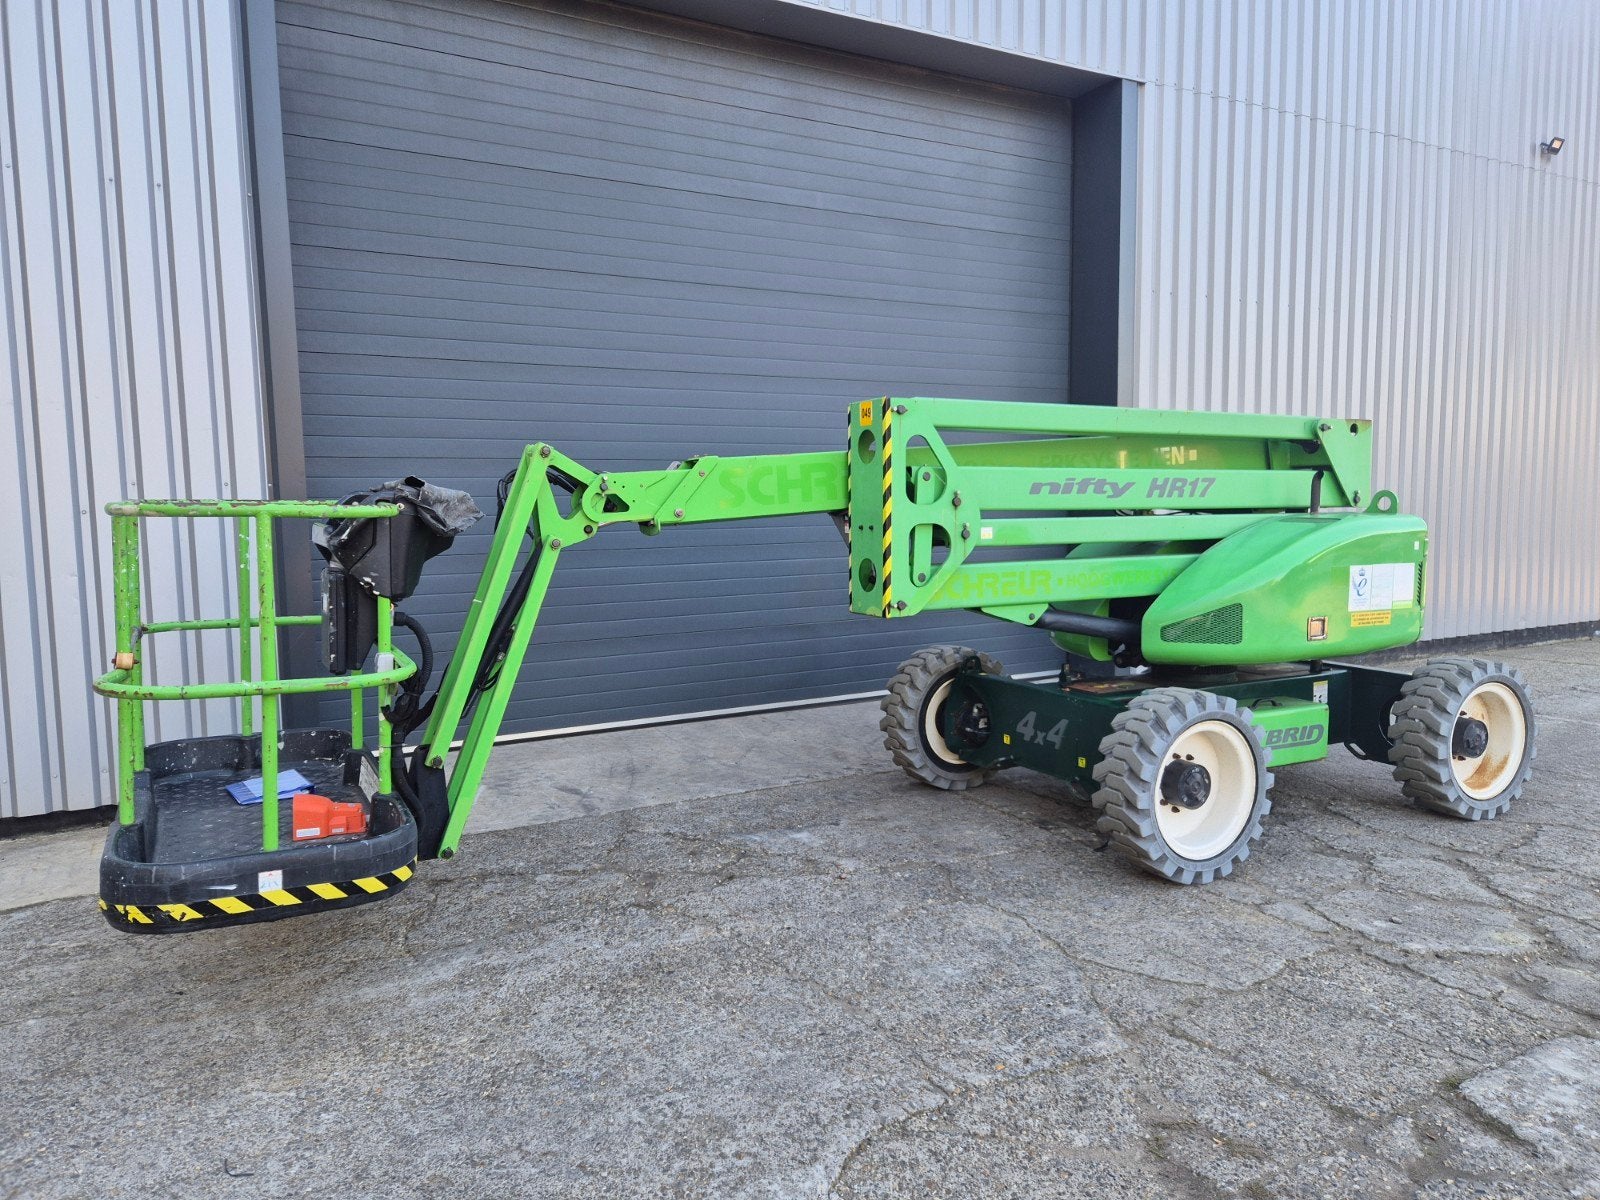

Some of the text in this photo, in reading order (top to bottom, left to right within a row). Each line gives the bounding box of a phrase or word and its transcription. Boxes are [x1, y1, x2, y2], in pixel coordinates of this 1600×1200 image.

[718, 462, 839, 509] SCHR
[1028, 478, 1216, 498] nifty HR17
[1016, 711, 1069, 750] 4x4
[1264, 724, 1325, 748] BRID
